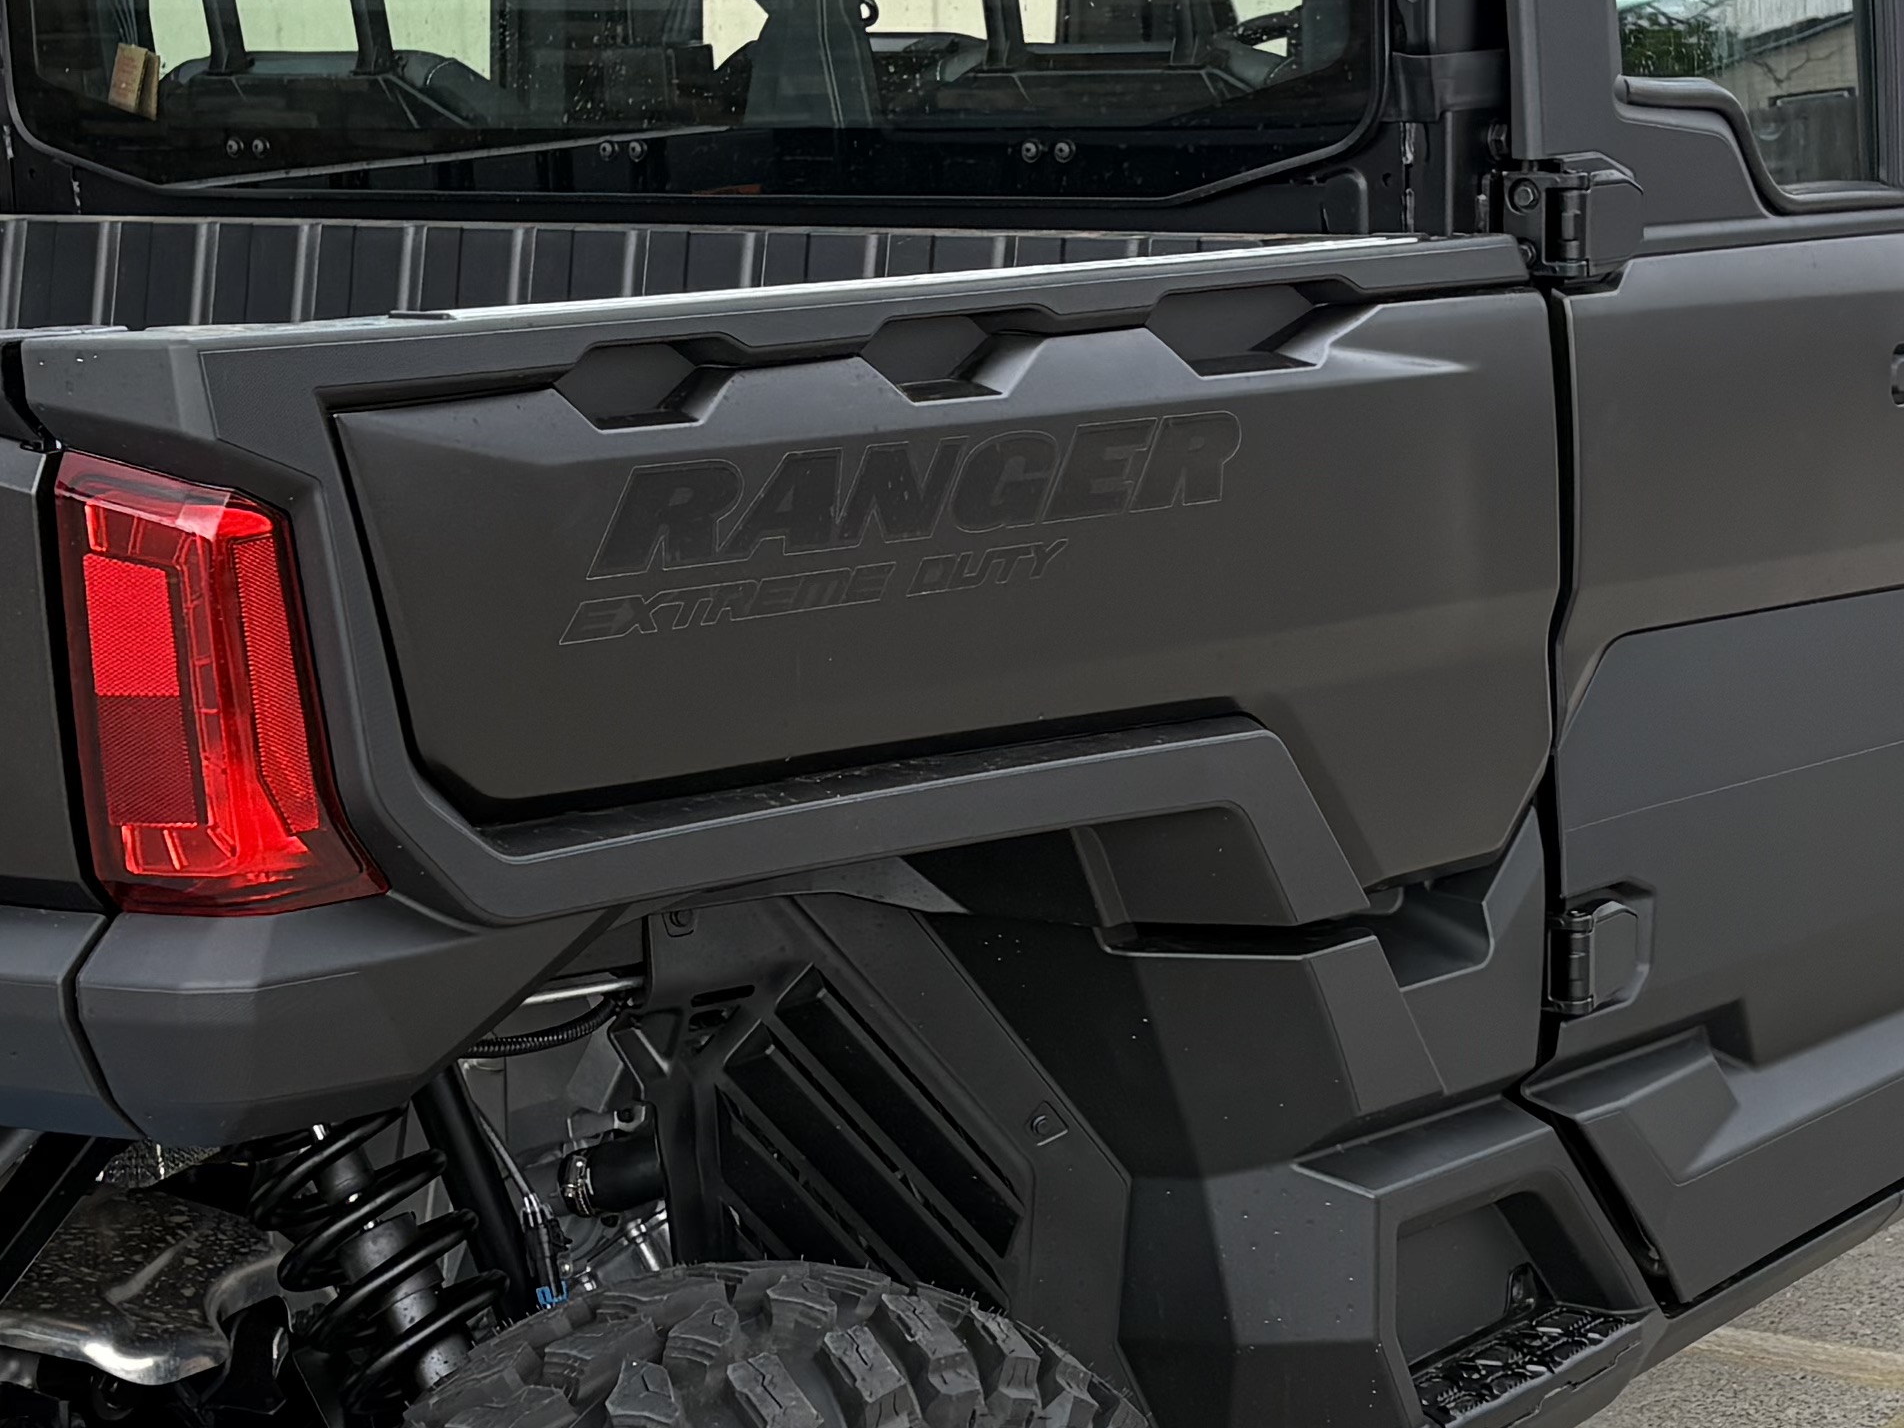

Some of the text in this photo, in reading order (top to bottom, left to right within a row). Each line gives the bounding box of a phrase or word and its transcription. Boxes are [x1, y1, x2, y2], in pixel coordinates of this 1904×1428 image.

[586, 410, 1242, 580] RANGER
[559, 538, 1068, 645] EXTREME DUTY
